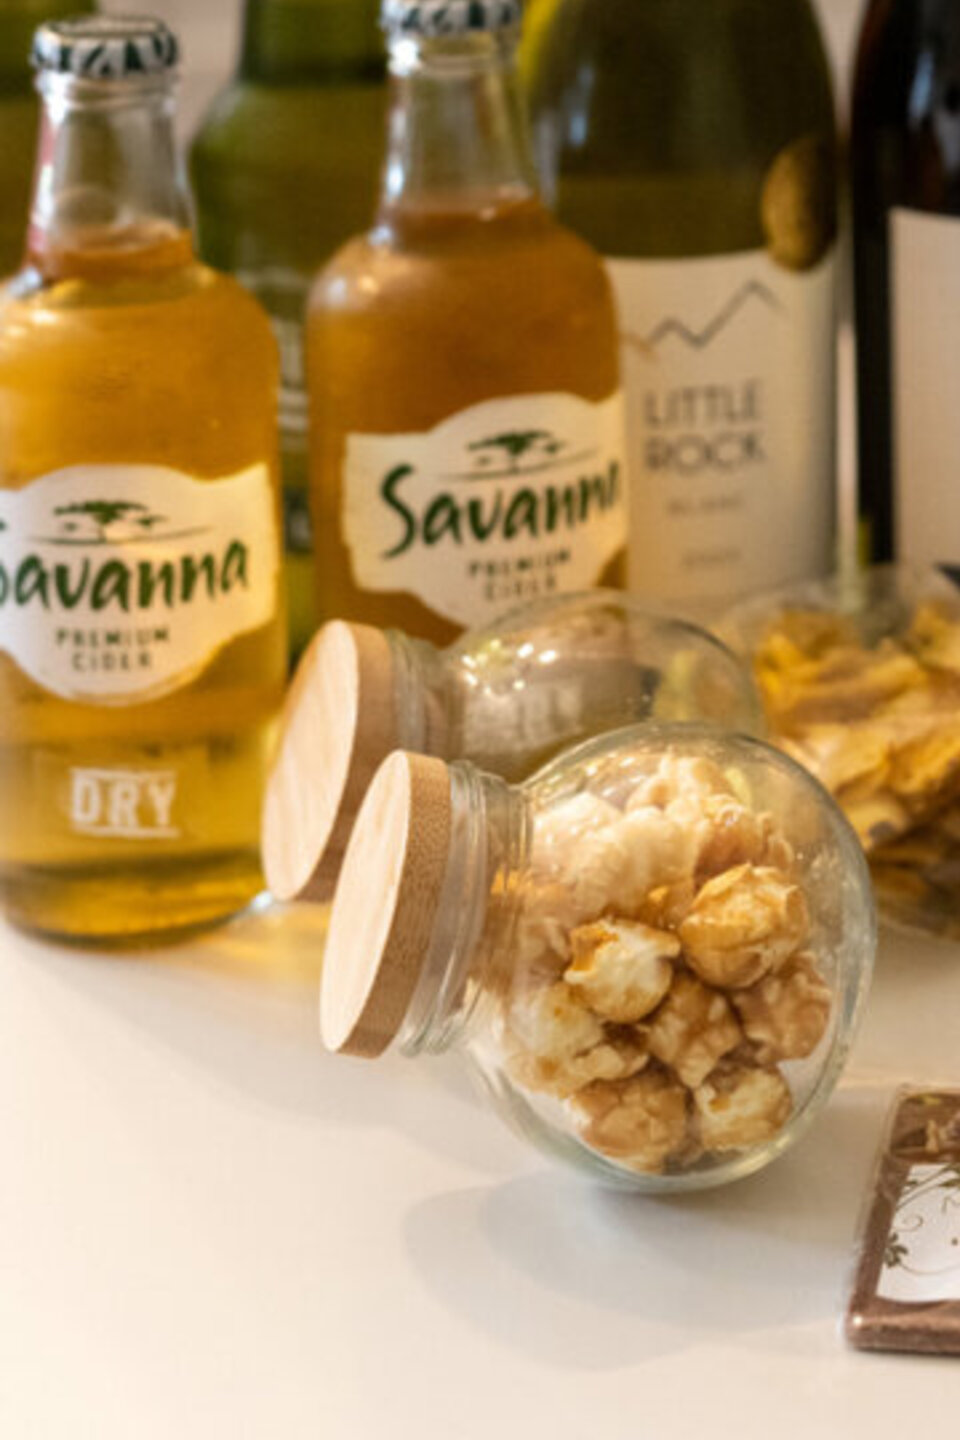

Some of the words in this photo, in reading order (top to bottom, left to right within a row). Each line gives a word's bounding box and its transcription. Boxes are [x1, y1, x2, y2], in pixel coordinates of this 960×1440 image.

[644, 376, 764, 430] LITTLE
[644, 430, 768, 478] ROCK
[56, 627, 170, 649] PREMIUM
[71, 652, 153, 673] CIDER
[70, 769, 176, 829] DRY
